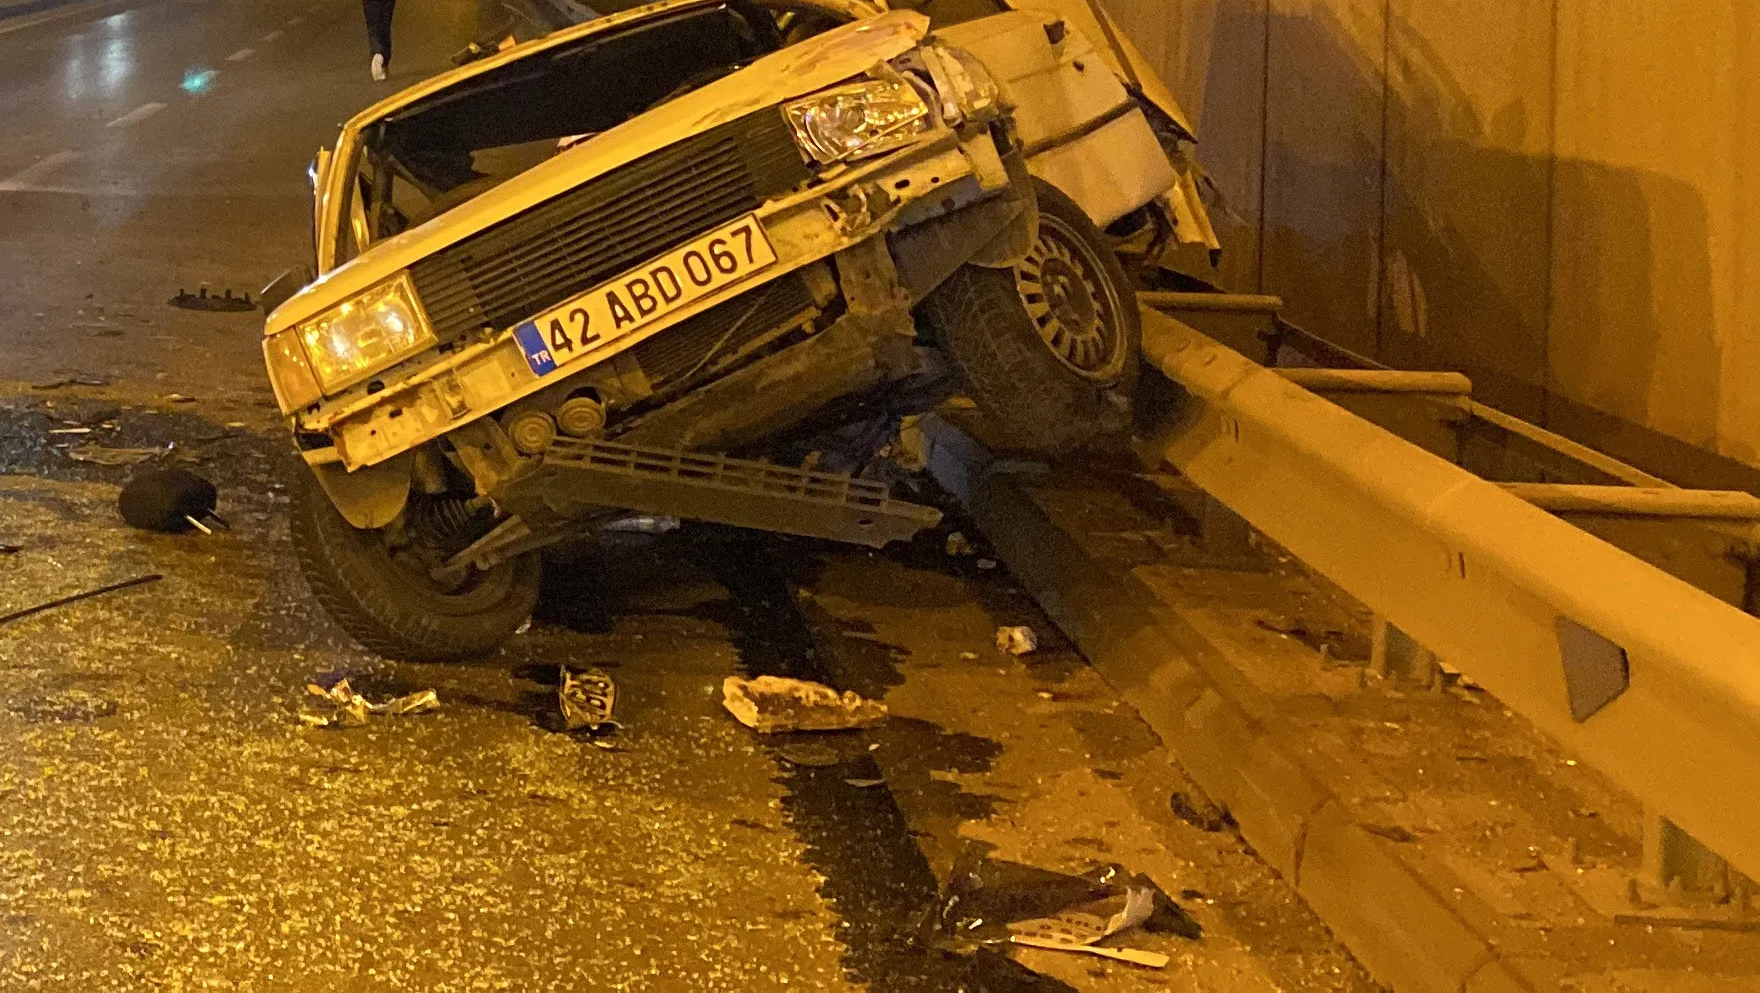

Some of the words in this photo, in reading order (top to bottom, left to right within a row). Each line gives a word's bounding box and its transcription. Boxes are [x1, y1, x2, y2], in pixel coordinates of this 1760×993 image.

[549, 307, 601, 353] 42
[605, 265, 683, 330] ABD
[682, 224, 755, 287] 067
[531, 349, 551, 365] TR
